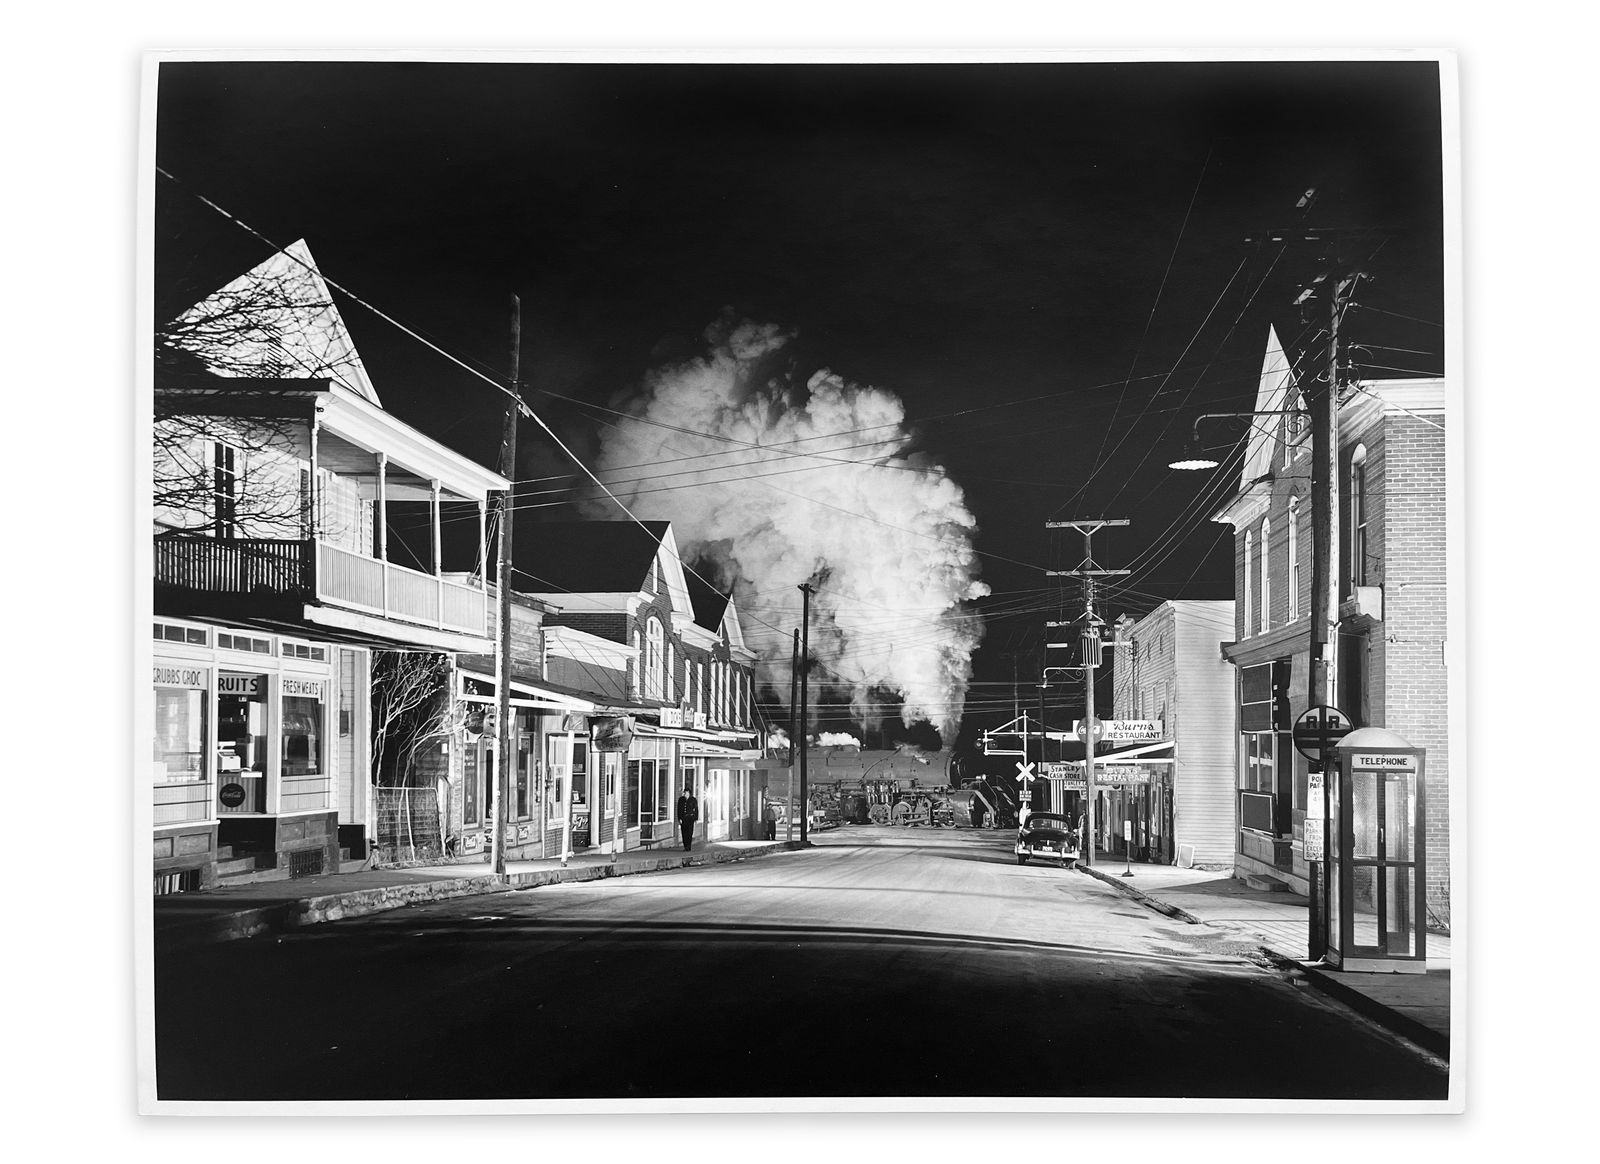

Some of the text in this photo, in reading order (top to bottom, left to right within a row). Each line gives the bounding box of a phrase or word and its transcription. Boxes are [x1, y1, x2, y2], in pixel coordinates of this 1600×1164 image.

[283, 679, 319, 695] FRESH MEATS
[1113, 720, 1156, 731] Burns
[1107, 731, 1162, 739] RESTAURANT
[1360, 757, 1408, 766] TELEPHONE
[1051, 765, 1081, 773] STANLEY
